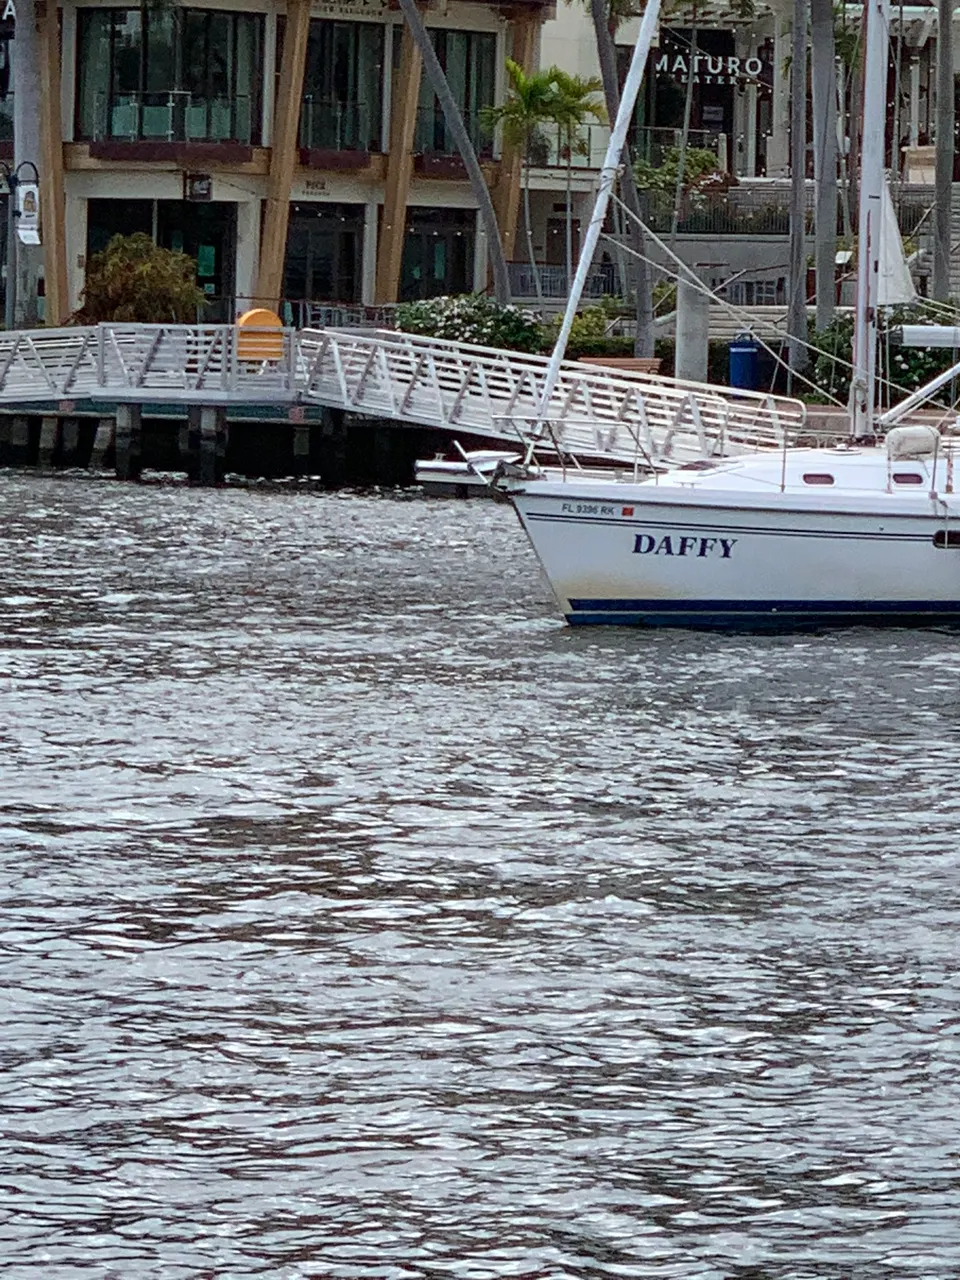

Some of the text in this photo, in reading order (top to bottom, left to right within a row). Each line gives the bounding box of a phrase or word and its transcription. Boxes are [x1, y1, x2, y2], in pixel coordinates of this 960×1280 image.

[561, 503, 574, 513] FL
[600, 506, 615, 516] RK
[632, 533, 738, 559] DAFFY
